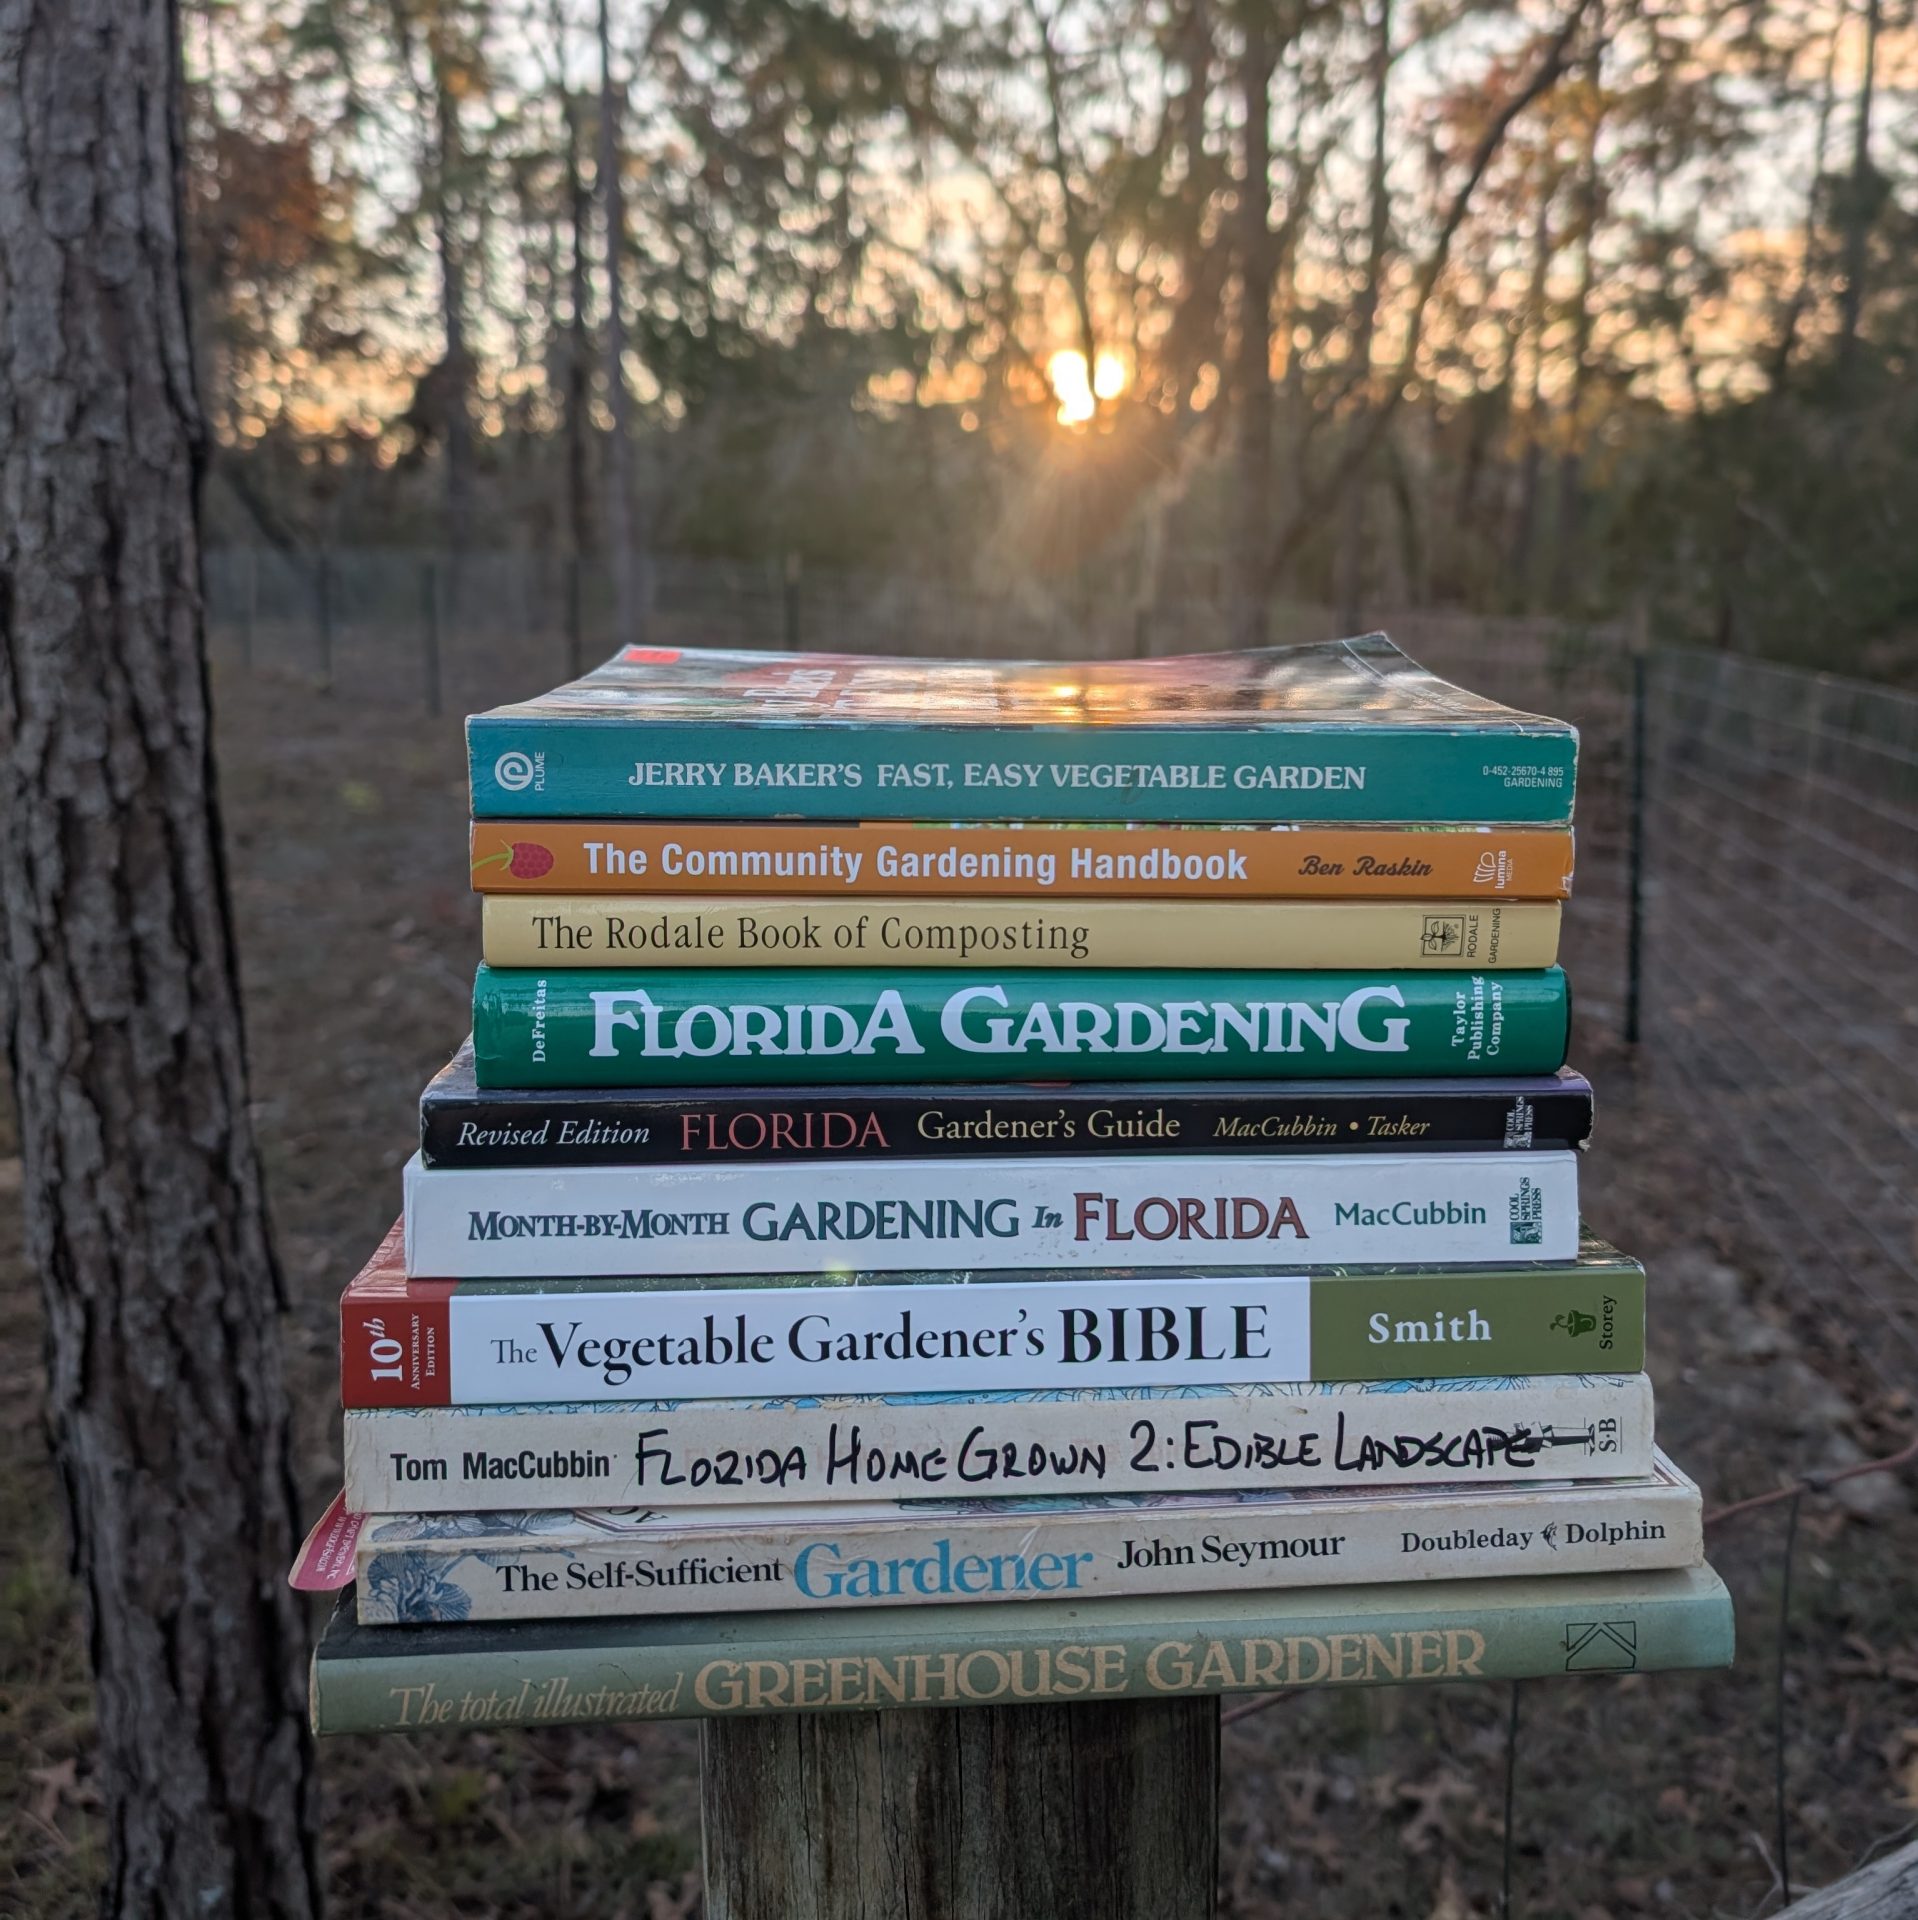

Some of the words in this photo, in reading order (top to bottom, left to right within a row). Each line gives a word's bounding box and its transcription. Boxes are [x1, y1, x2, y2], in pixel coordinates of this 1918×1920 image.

[535, 752, 545, 791] PLUME
[628, 762, 726, 787] JERRY
[733, 762, 862, 787] BAKER'S
[877, 763, 953, 789] FAST,
[963, 764, 1043, 788] EASY
[1050, 764, 1227, 789] VEGETABLE
[1233, 765, 1366, 790] GARDEN
[1504, 777, 1562, 788] GARDENING
[1548, 767, 1564, 776] 895
[583, 841, 647, 875] The
[662, 843, 862, 883] Community
[877, 845, 1056, 885] Gardening
[1070, 847, 1247, 880] Handbook
[1298, 855, 1344, 877] Ben
[1352, 856, 1433, 877] Raskin
[1495, 850, 1507, 889] lumina
[532, 916, 592, 950] The
[606, 916, 724, 949] Rodale
[737, 916, 820, 950] Book
[833, 915, 868, 950] of
[881, 916, 1090, 959] Composting
[1467, 914, 1479, 957] RODALE
[1488, 908, 1501, 963] GARDENING
[533, 979, 547, 1062] DeFreitas
[588, 989, 925, 1058] FLORIDA
[940, 985, 1411, 1055] GARDENING
[1452, 992, 1467, 1047] Taylor
[1467, 976, 1485, 1060] Publishing
[1486, 982, 1504, 1056] Company
[456, 1121, 548, 1147] Revised
[556, 1120, 650, 1146] Edition
[680, 1111, 891, 1150] FLORIDA
[917, 1109, 1075, 1141] Gardener's
[1088, 1109, 1181, 1139] Guide
[1213, 1116, 1337, 1137] MacCubbin
[1367, 1115, 1430, 1138] Tasker
[468, 1209, 729, 1241] MONTH-BY-MONTH
[742, 1199, 1019, 1242] GARDENING
[1032, 1205, 1063, 1230] In
[1073, 1192, 1310, 1242] FLORIDA
[1334, 1201, 1487, 1228] MacCubbin
[1509, 1193, 1520, 1221] COOL
[1520, 1177, 1531, 1221] SPRINGS
[1531, 1187, 1542, 1220] PRESS
[1368, 1309, 1492, 1344] Smith
[1600, 1295, 1617, 1350] Storey
[362, 1317, 403, 1382] 10th
[411, 1313, 420, 1390] ANNIVERSARY
[425, 1327, 436, 1377] EDITION
[490, 1338, 538, 1364] The
[537, 1314, 775, 1386] Vegetable
[788, 1308, 1045, 1363] Gardener's
[1058, 1304, 1272, 1364] BIBLE
[1335, 1411, 1535, 1472] LANDSCAPE
[390, 1453, 447, 1481] Tom
[463, 1449, 610, 1480] MacCubbin
[1400, 1529, 1533, 1554] Doubleday
[1564, 1520, 1666, 1546] Dolphin
[495, 1564, 558, 1592] The
[566, 1556, 785, 1591] Self-Sufficient
[795, 1539, 1093, 1598] Gardener
[1117, 1536, 1194, 1569] John
[1202, 1534, 1346, 1567] Seymour
[390, 1682, 452, 1726] The
[459, 1679, 530, 1722] total
[533, 1671, 683, 1720] illustrated
[695, 1644, 1128, 1713] GREENHOUSE
[1146, 1628, 1488, 1691] GARDENER
